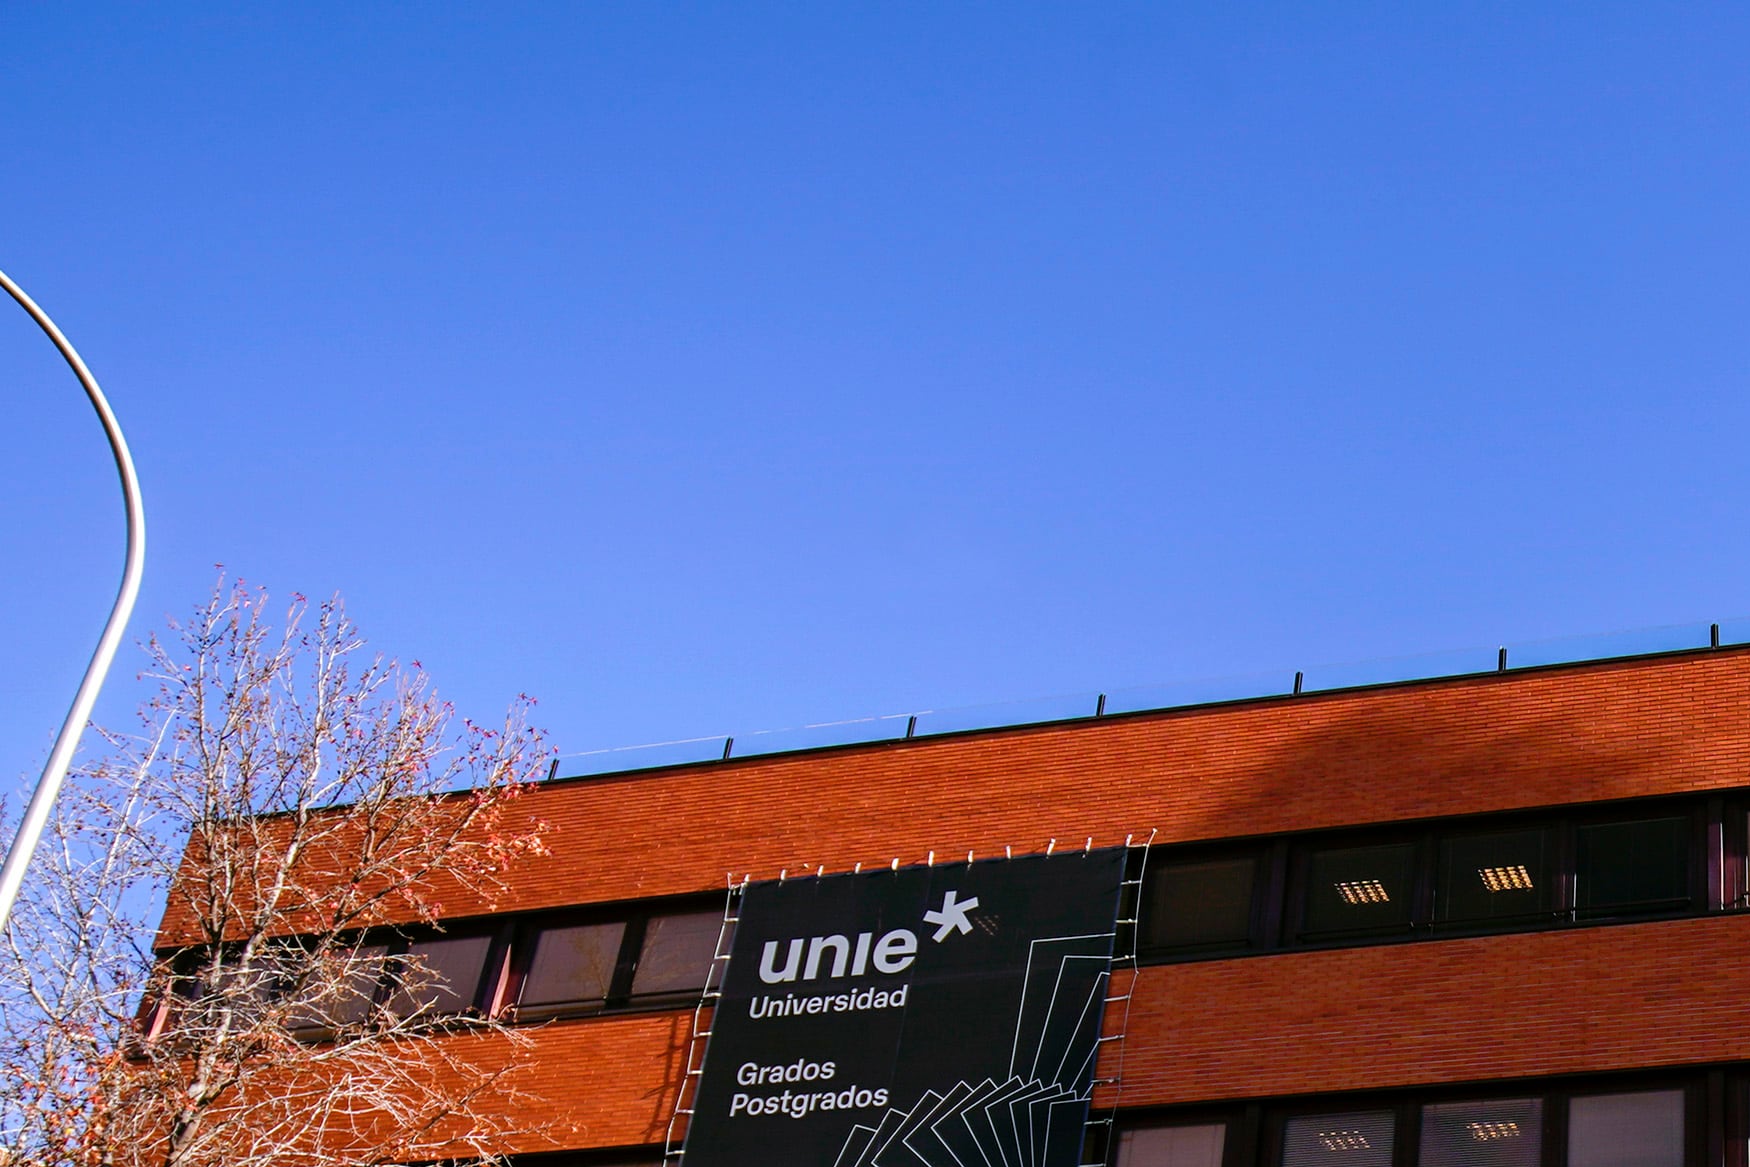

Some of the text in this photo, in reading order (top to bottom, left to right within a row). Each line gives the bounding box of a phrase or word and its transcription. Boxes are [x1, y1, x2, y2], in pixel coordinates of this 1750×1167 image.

[749, 984, 909, 1019] Universidad
[737, 1058, 836, 1086] Grados
[729, 1085, 889, 1119] Postgrados
